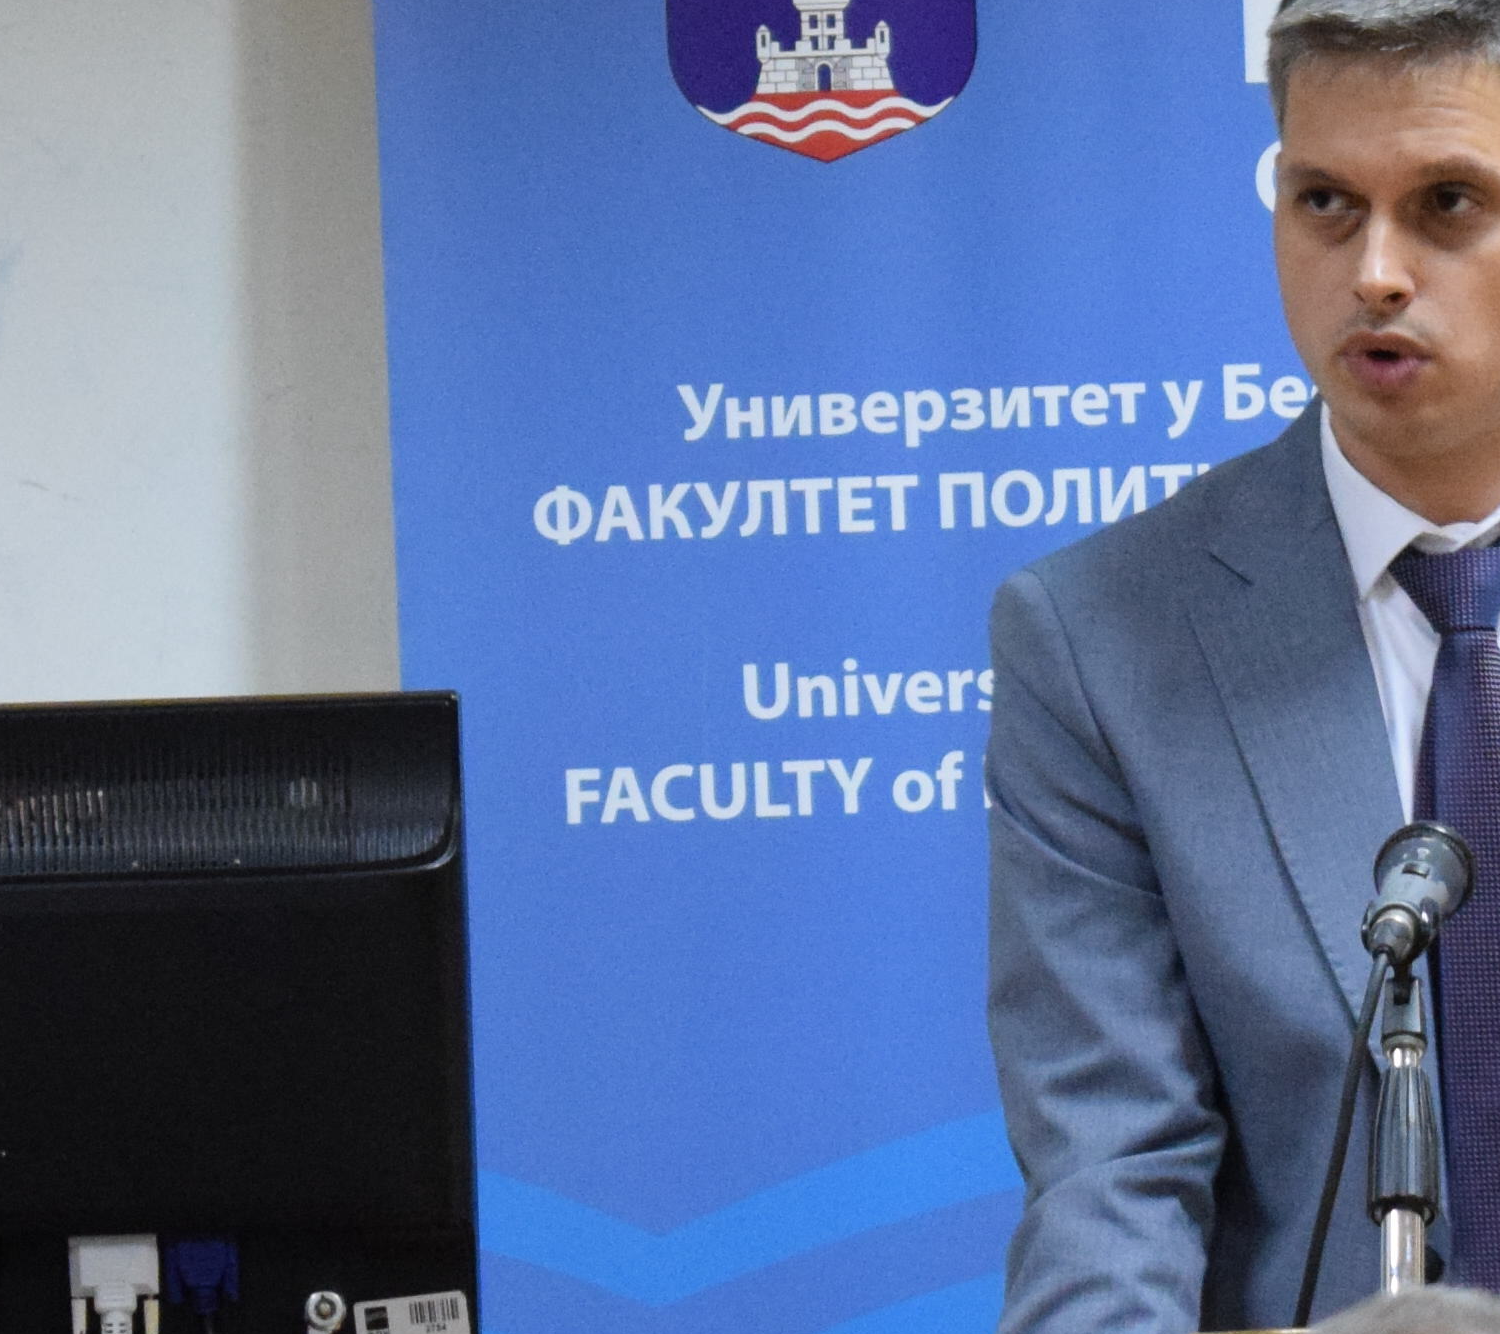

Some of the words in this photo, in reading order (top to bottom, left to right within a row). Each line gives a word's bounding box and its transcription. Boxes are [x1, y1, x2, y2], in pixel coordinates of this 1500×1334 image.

[678, 382, 1146, 447] Универзитет
[1162, 380, 1203, 439] у
[1222, 363, 1319, 421] Бе
[533, 474, 919, 546] ФАКУЛТЕТ
[939, 463, 1211, 529] ПОЛИТ
[565, 757, 873, 825] FACULTY
[892, 750, 964, 813] of
